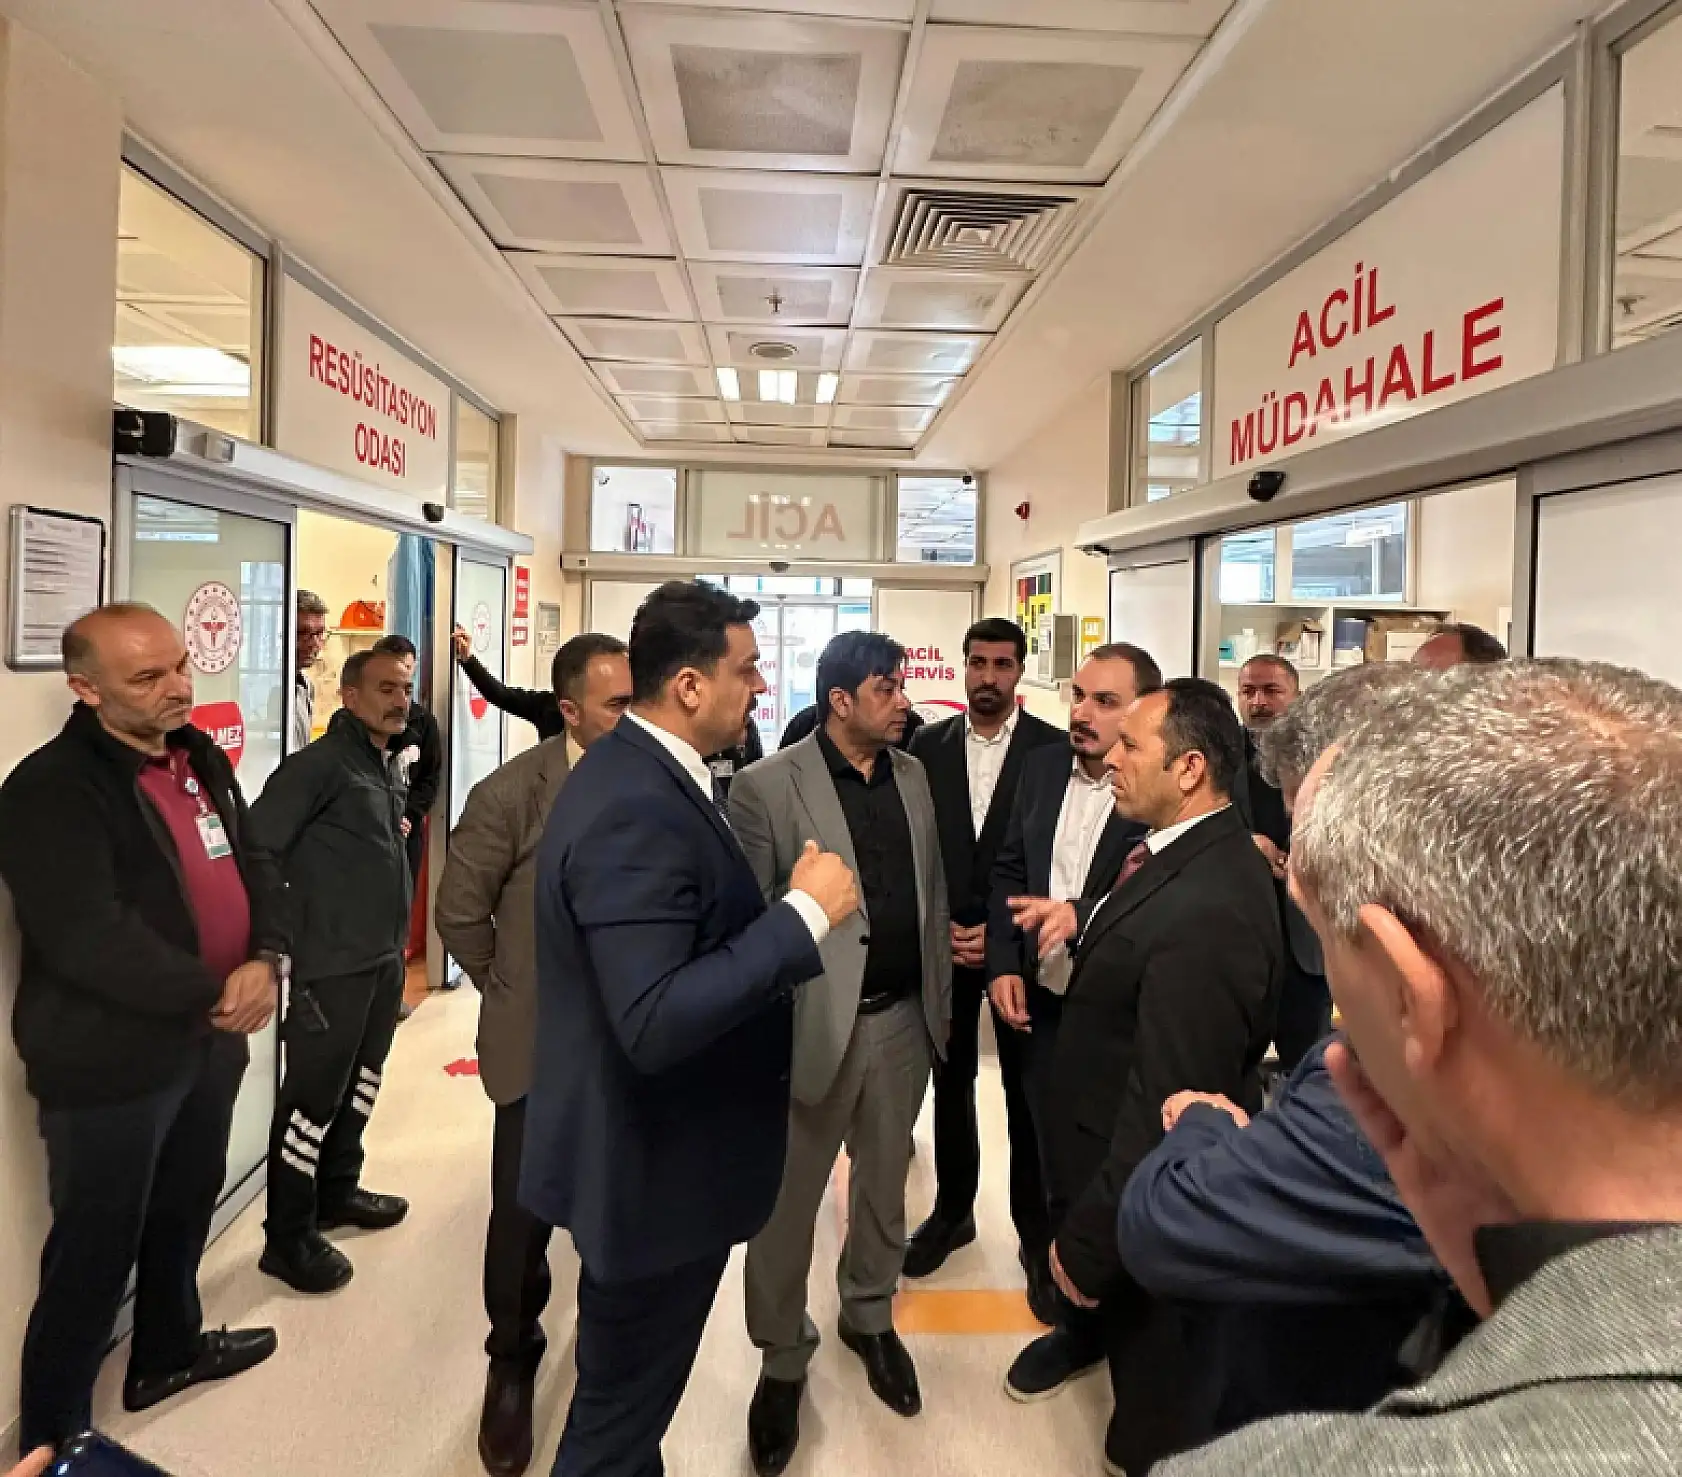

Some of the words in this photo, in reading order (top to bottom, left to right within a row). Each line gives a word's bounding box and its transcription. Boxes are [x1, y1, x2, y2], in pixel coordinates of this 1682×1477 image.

[1288, 261, 1396, 368] ACİL
[310, 334, 437, 440] RESÜSİTASYON
[1231, 297, 1504, 465] MÜDAHALE
[355, 422, 406, 478] ODASI
